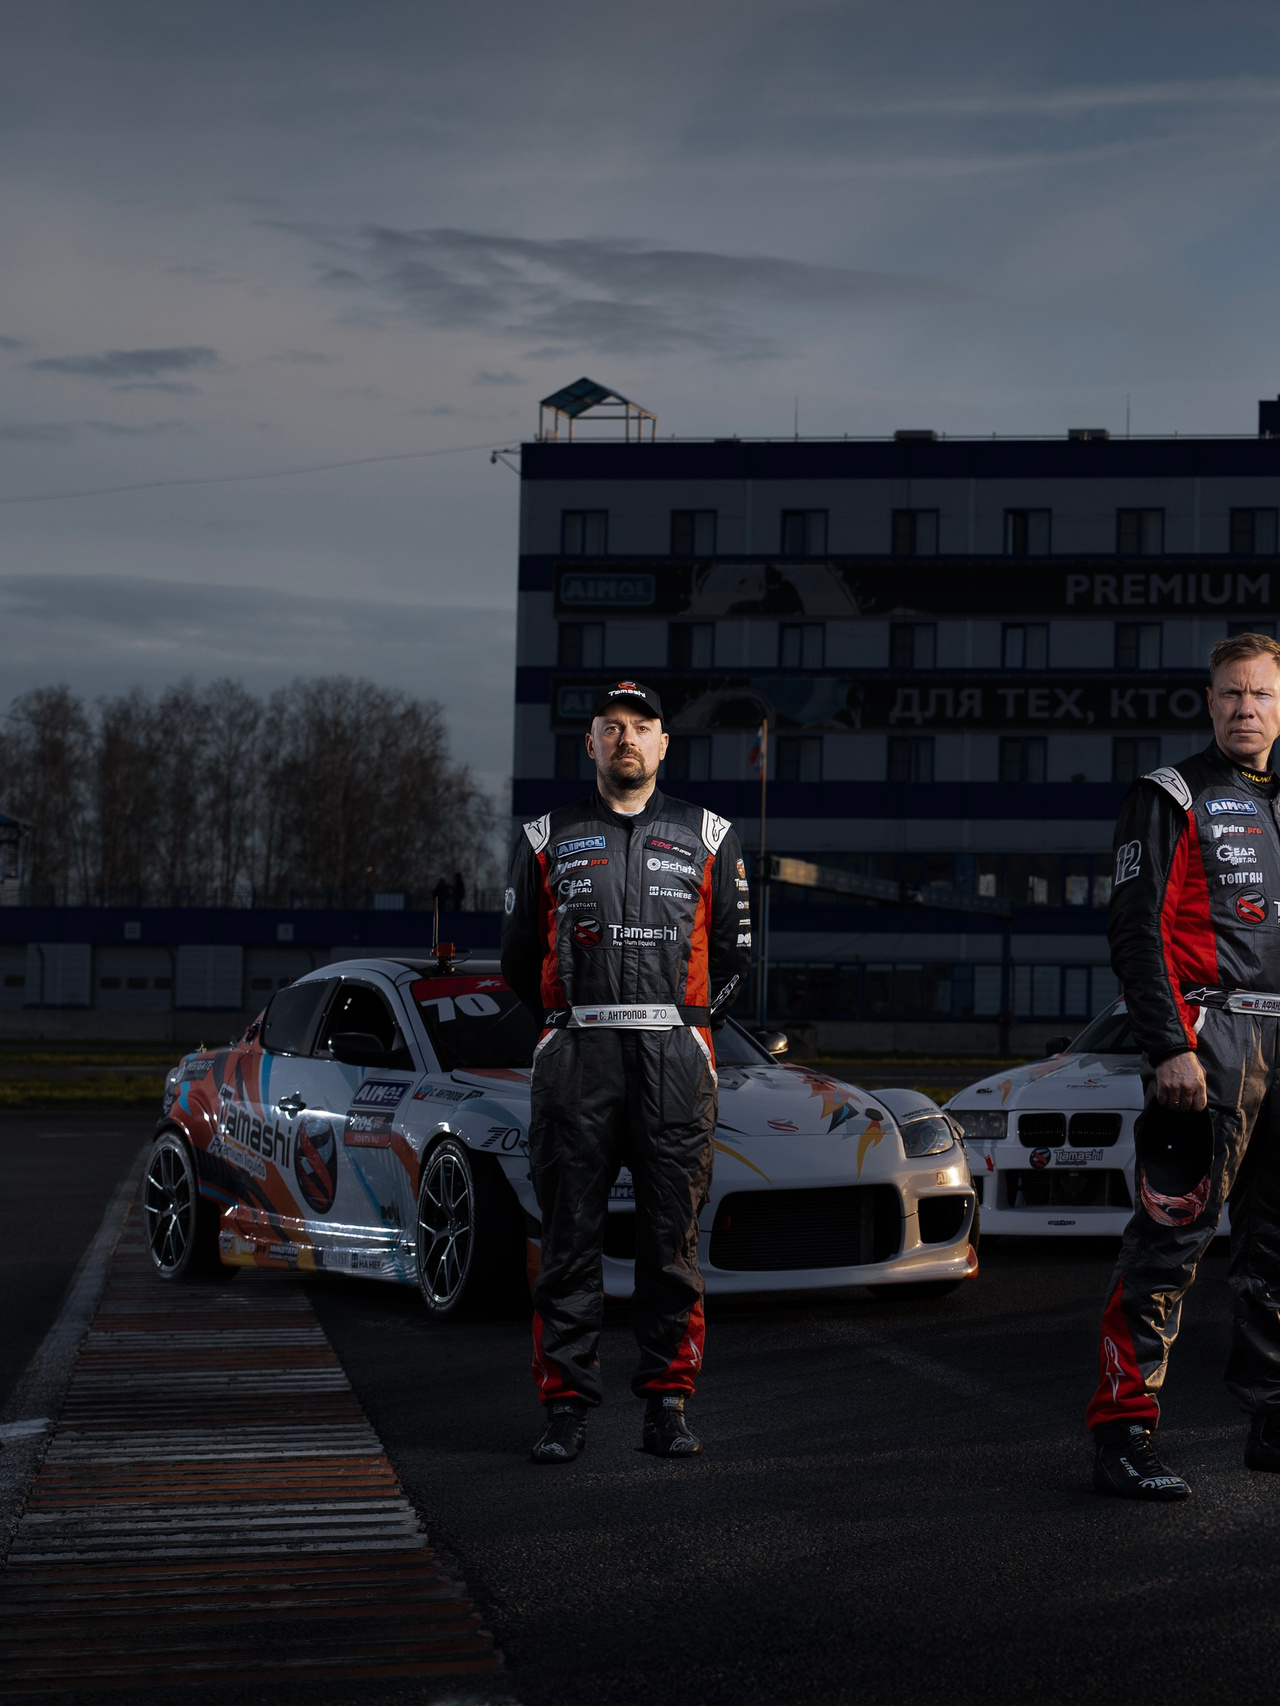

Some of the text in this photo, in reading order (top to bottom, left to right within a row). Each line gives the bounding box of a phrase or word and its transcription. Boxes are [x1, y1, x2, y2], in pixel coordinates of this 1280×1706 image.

[565, 580, 649, 598] AIMOL
[1065, 573, 1270, 606] PREMIUM
[608, 689, 647, 699] Tamashi
[889, 687, 983, 725] ДЛЯ
[999, 687, 1096, 726] ТЕХ,
[1110, 687, 1202, 720] КТО
[1211, 801, 1255, 812] AIMOL
[1211, 824, 1263, 839] Vedro.pro
[558, 837, 604, 856] AIMOL
[1216, 844, 1256, 862] GEAR
[1114, 839, 1142, 886] 12
[1219, 872, 1263, 885] ТОПГАН
[608, 924, 678, 941] Tamashi
[419, 992, 501, 1024] 70
[608, 1010, 647, 1020] АНТРОПОВ
[354, 1084, 405, 1103] AIMOL
[218, 1086, 293, 1169] Tamashi
[1054, 1149, 1104, 1161] Tamashi
